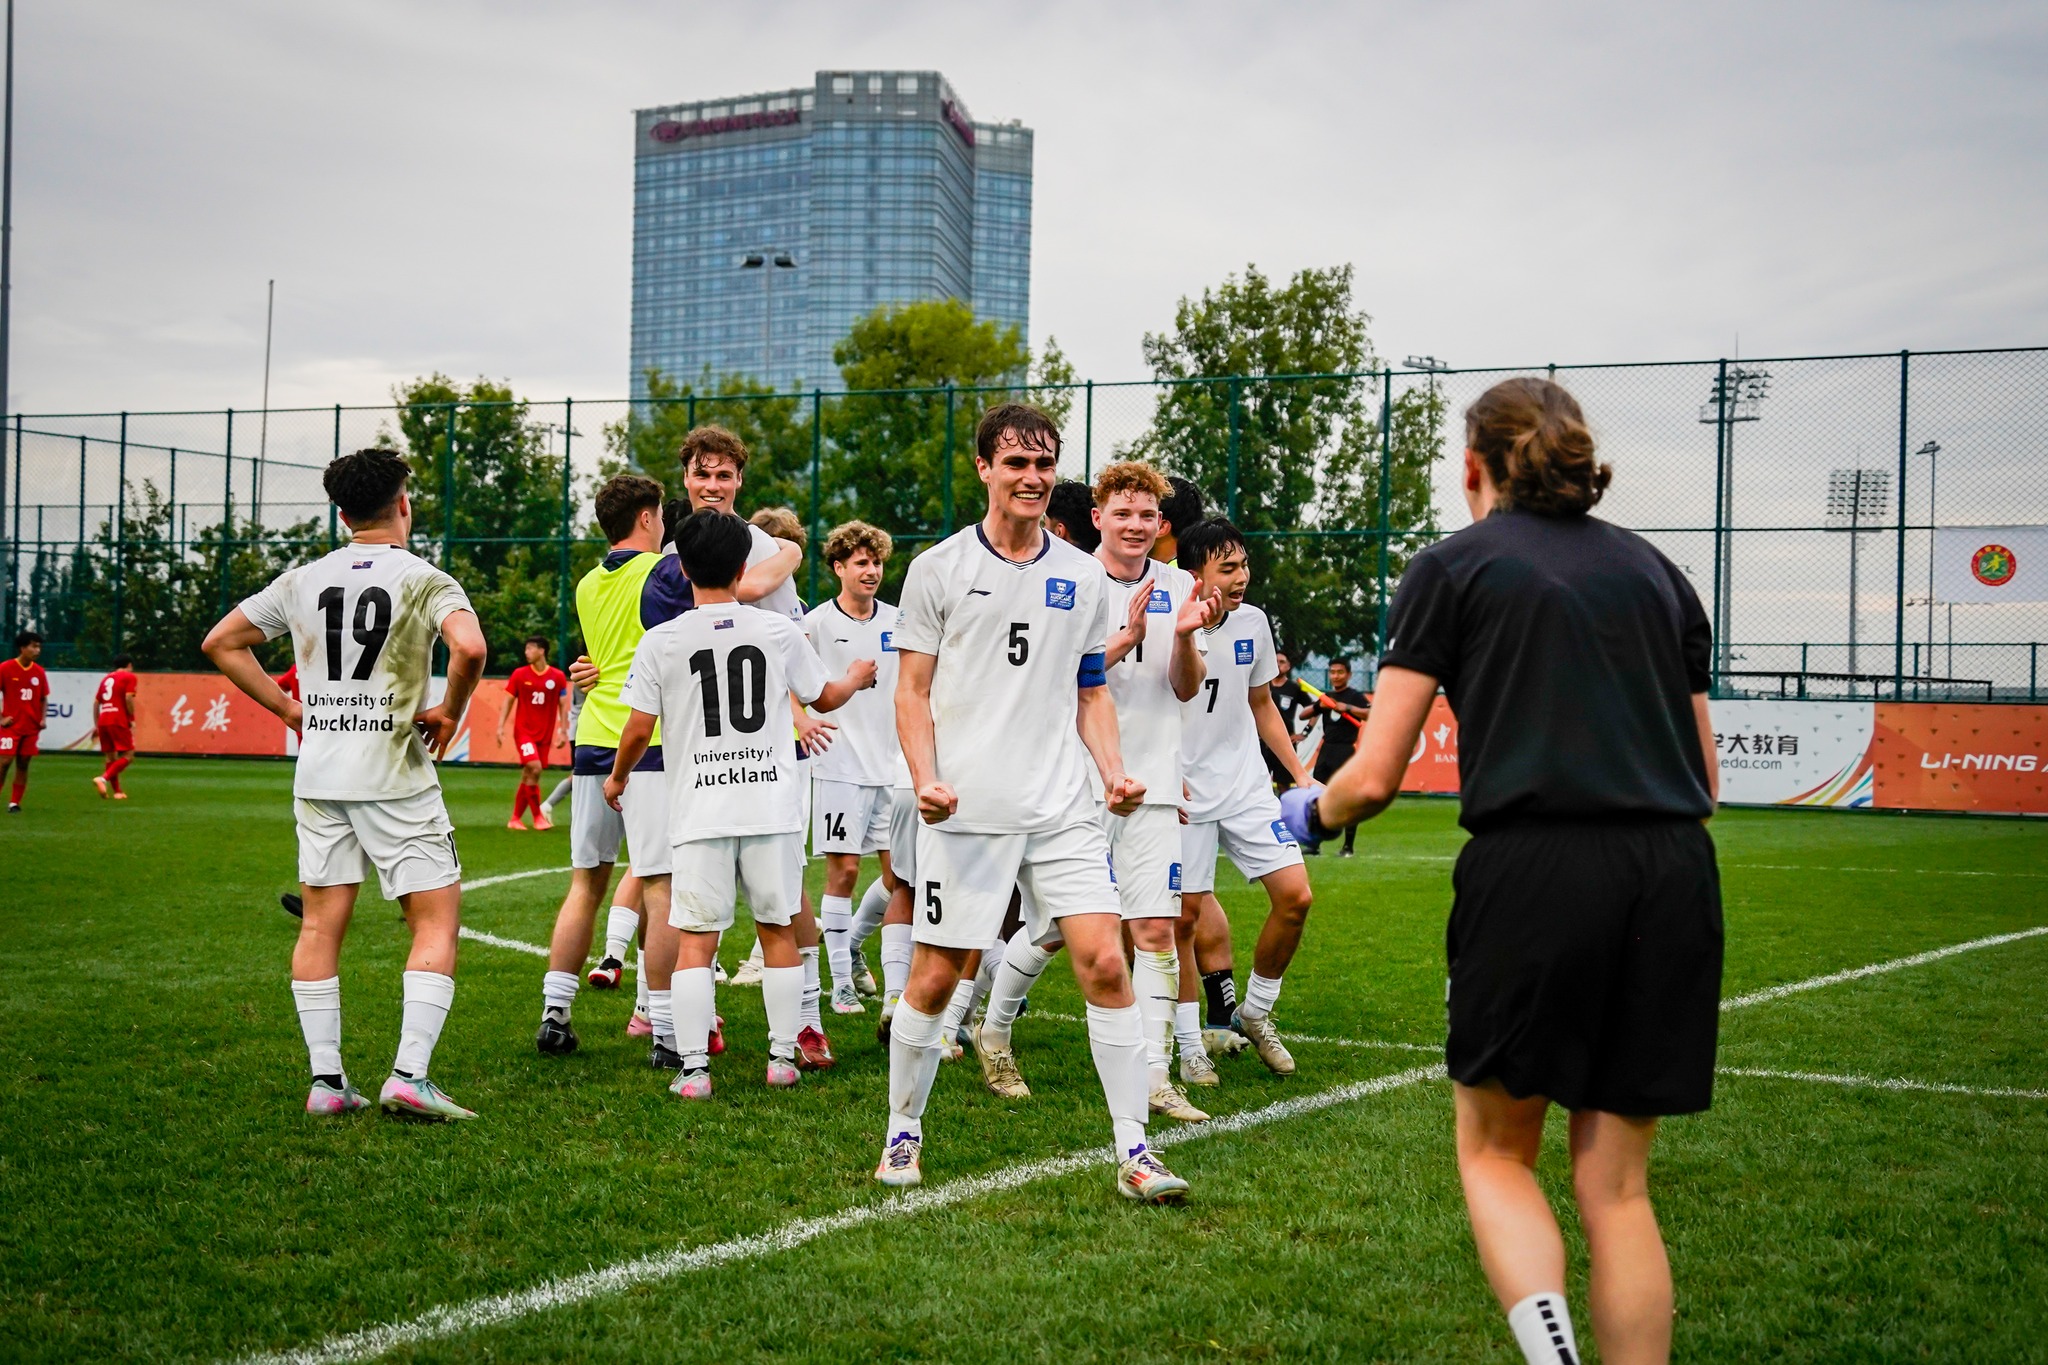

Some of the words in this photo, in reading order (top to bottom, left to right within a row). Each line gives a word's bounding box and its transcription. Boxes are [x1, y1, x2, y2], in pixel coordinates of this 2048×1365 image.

[318, 586, 392, 681] 19
[1007, 622, 1030, 667] 5
[20, 688, 33, 701] 20
[102, 677, 115, 701] 3
[689, 645, 767, 738] 10
[1204, 679, 1220, 713] 7
[307, 693, 377, 710] University
[380, 693, 394, 706] of
[307, 714, 394, 731] Auckland
[694, 747, 764, 765] University
[1717, 757, 1782, 770] eda.com
[1920, 752, 2038, 772] LI-NING
[695, 765, 778, 789] Auckland
[825, 812, 847, 841] 14
[926, 880, 942, 925] 5
